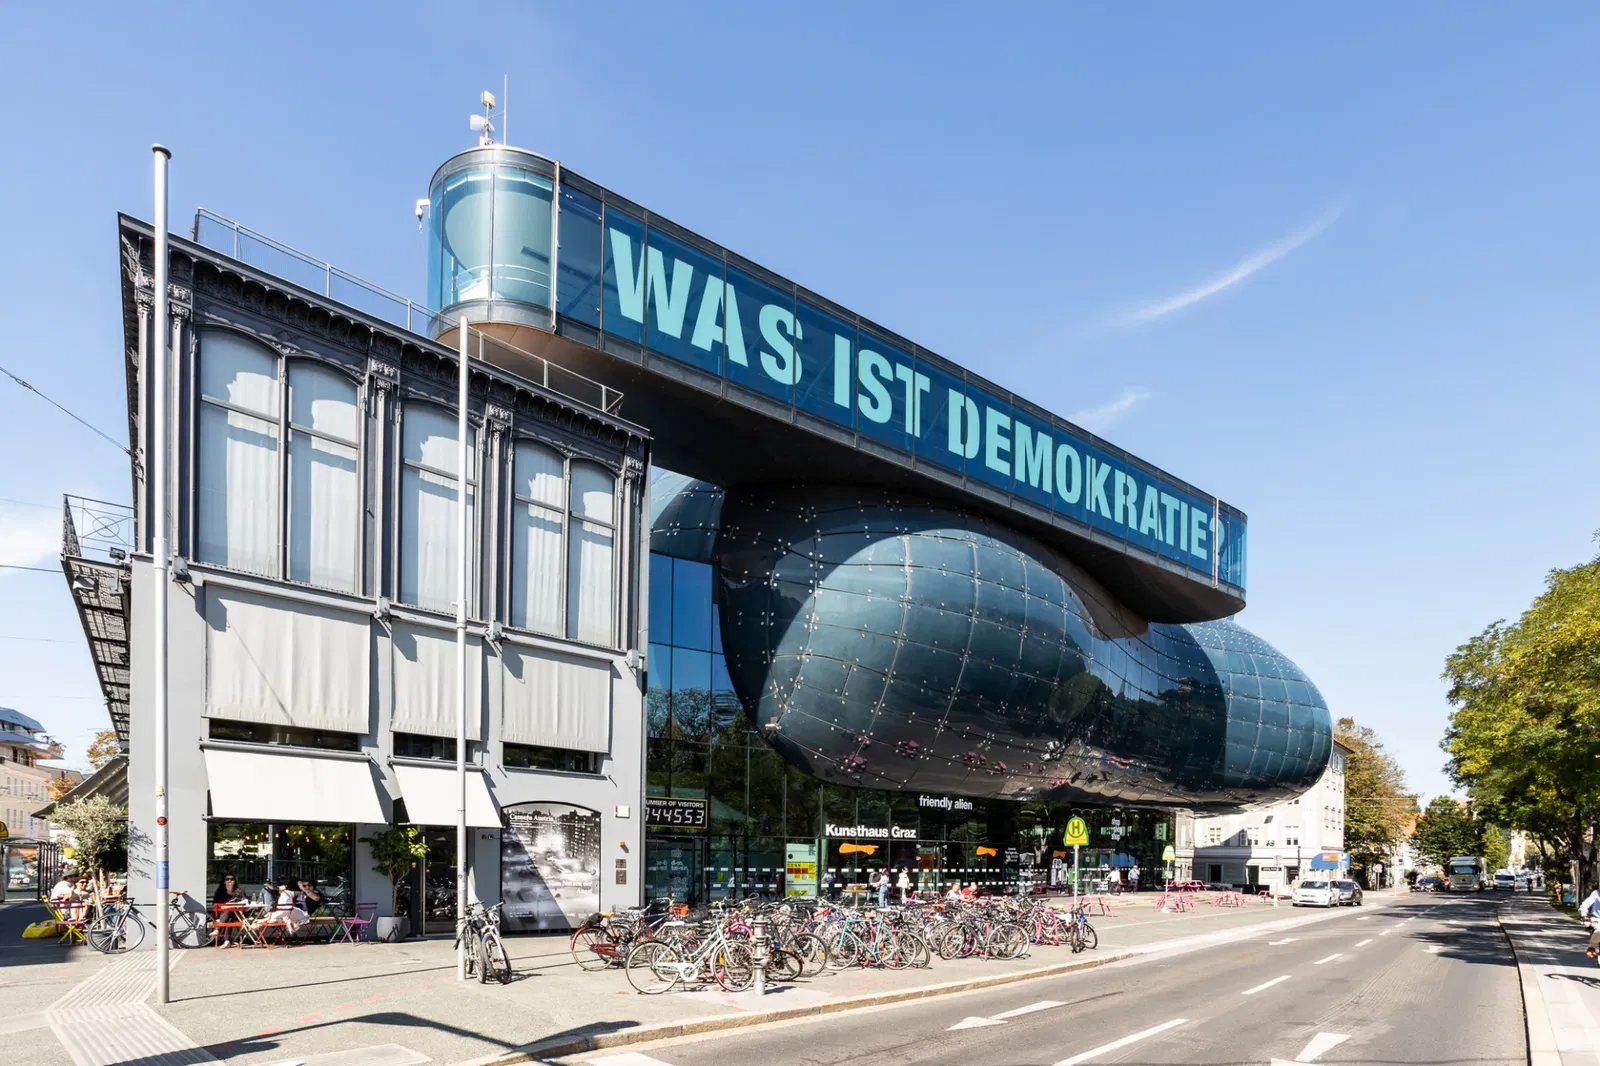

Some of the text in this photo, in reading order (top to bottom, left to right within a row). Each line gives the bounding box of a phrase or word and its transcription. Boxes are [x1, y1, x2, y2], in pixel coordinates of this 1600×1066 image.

[609, 226, 1226, 567] WAS IST DEMOKRATIE?
[919, 795, 973, 811] friendly alien
[825, 823, 917, 839] Kunsthaus Graz
[1071, 821, 1080, 835] H
